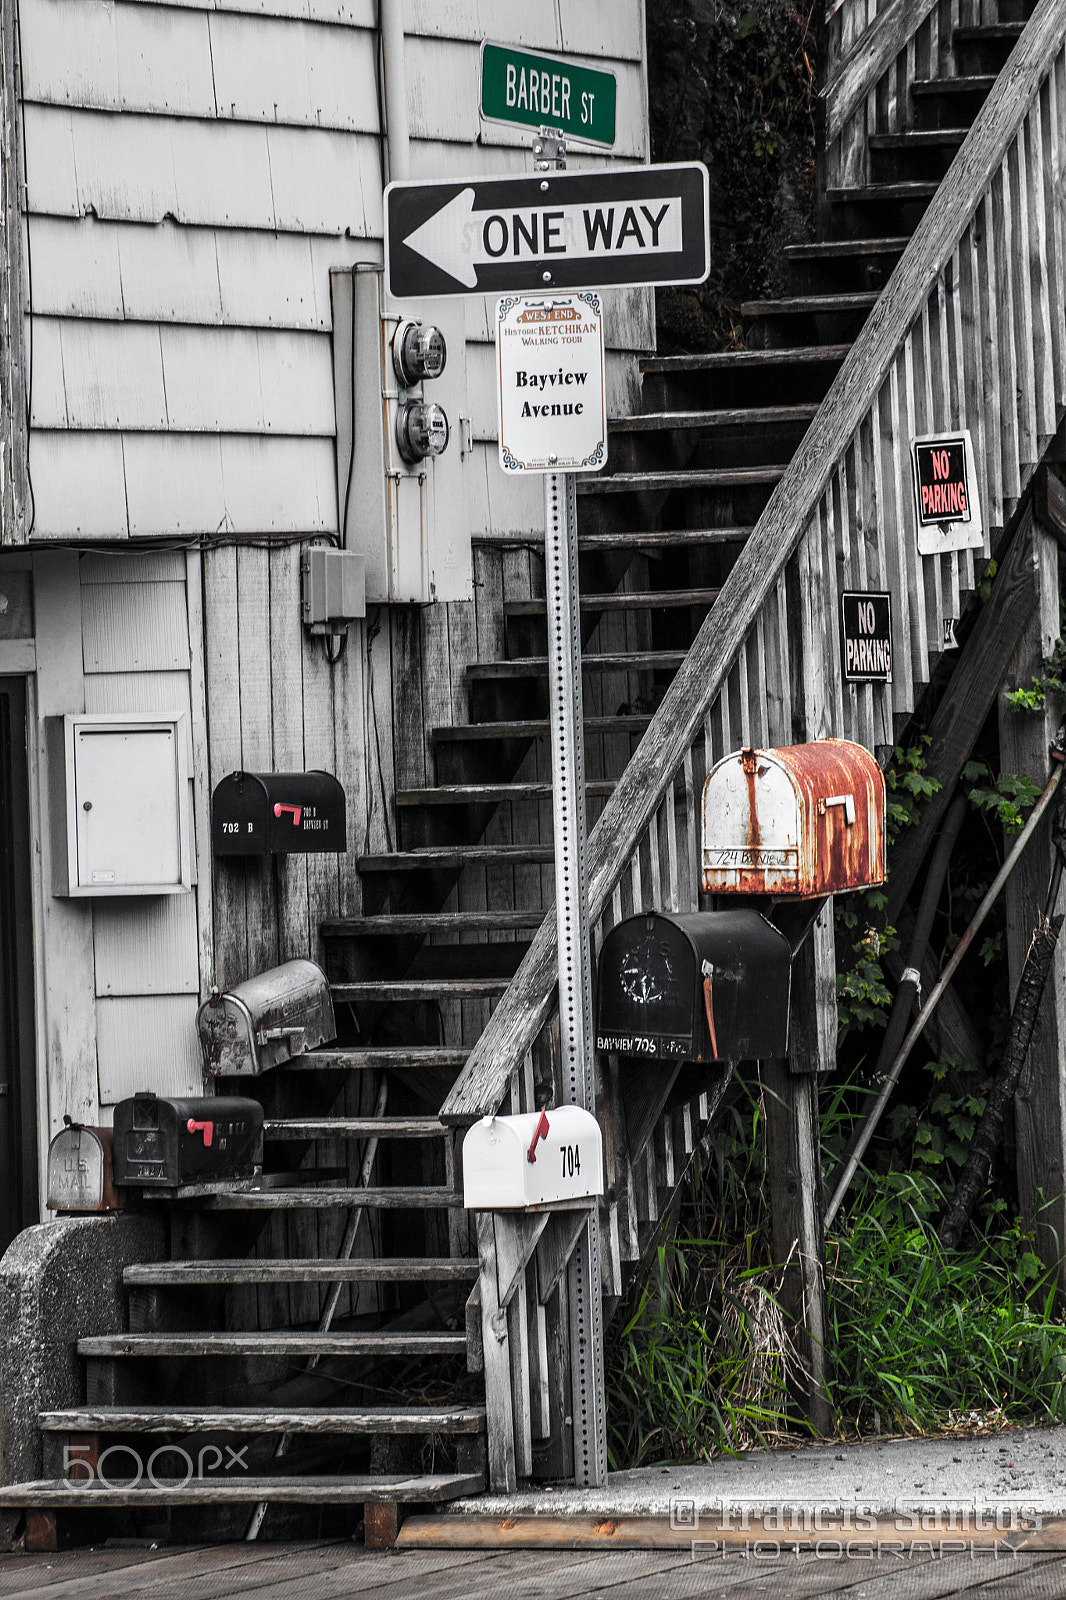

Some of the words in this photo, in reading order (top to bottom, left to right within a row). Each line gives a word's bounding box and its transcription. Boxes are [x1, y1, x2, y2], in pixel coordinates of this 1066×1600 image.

[505, 63, 571, 120] BARBER
[580, 91, 595, 125] ST
[482, 211, 567, 258] ONE
[582, 203, 671, 252] WAY
[525, 311, 552, 321] WEST
[554, 310, 574, 320] END
[538, 323, 597, 336] KETCHIKAN
[561, 336, 583, 344] TOUR
[515, 368, 588, 391] Bayview
[520, 401, 584, 418] Avenue
[932, 450, 950, 480] NO
[921, 481, 967, 515] PARKING
[857, 601, 876, 635] NO
[846, 639, 891, 672] PARKING
[222, 822, 240, 833] 702
[247, 822, 254, 833] B
[714, 850, 738, 865] 724
[634, 1037, 656, 1053] 706
[560, 1144, 581, 1178] 704
[58, 1174, 91, 1189] MAIL
